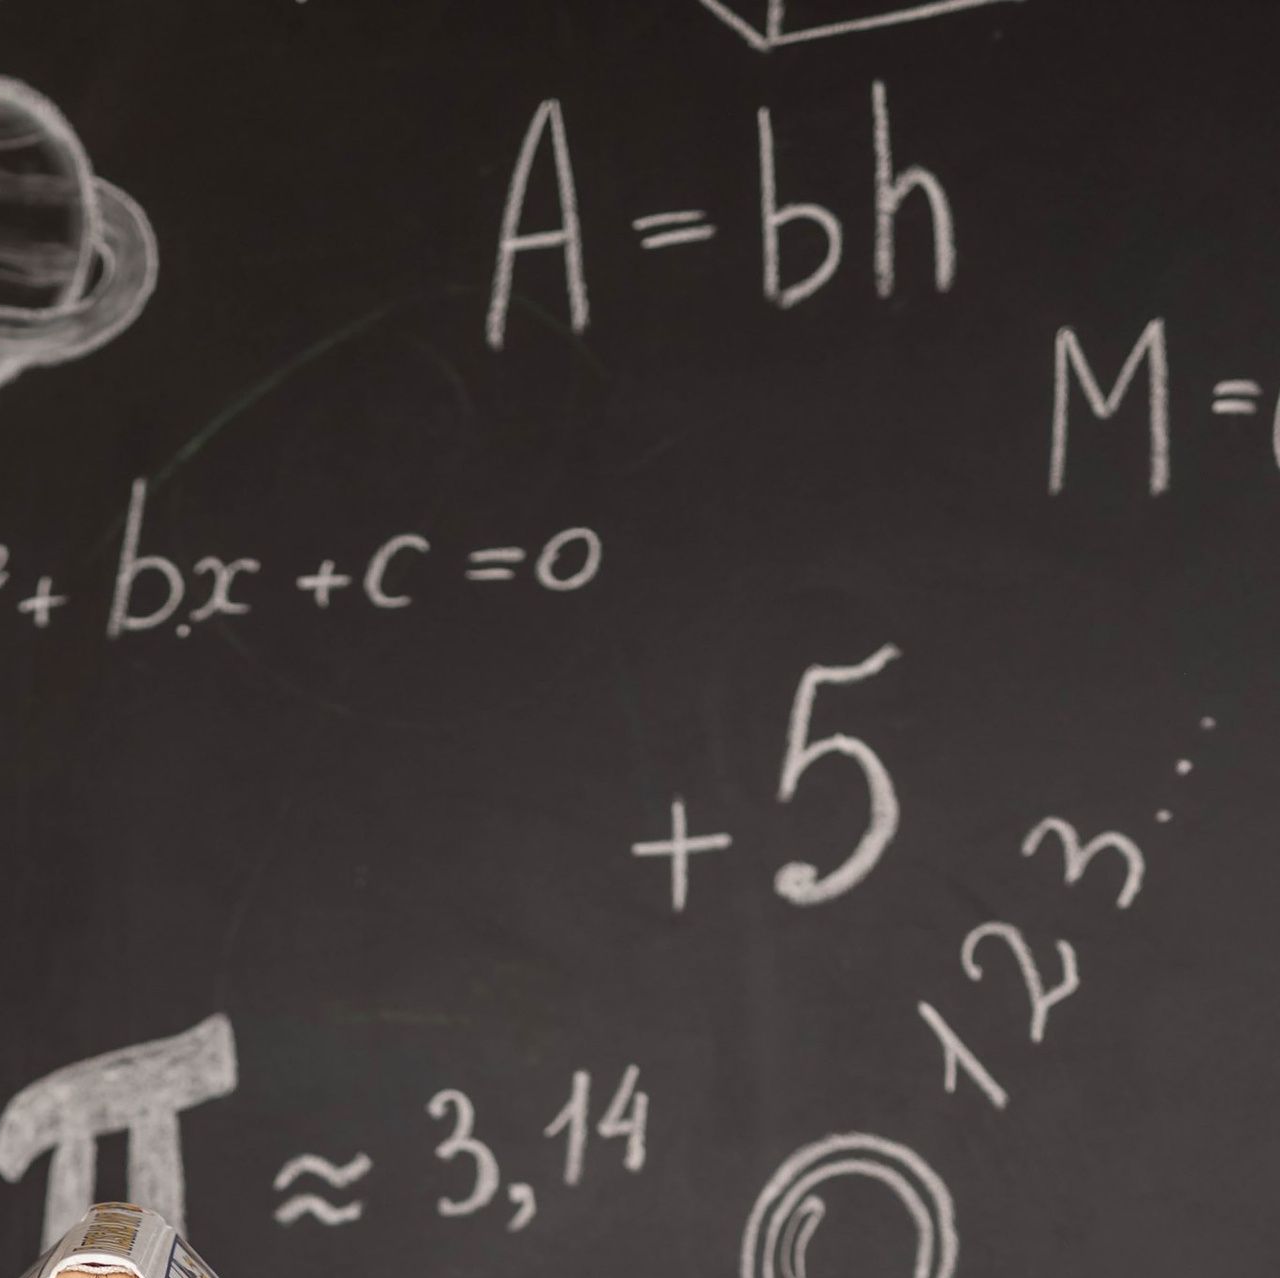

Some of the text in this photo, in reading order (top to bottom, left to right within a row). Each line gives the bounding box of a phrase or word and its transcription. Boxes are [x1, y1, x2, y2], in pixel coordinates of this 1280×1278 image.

[485, 98, 590, 348] A
[758, 80, 957, 309] bh
[1048, 318, 1170, 497] M
[427, 1063, 649, 1232] 3,14
